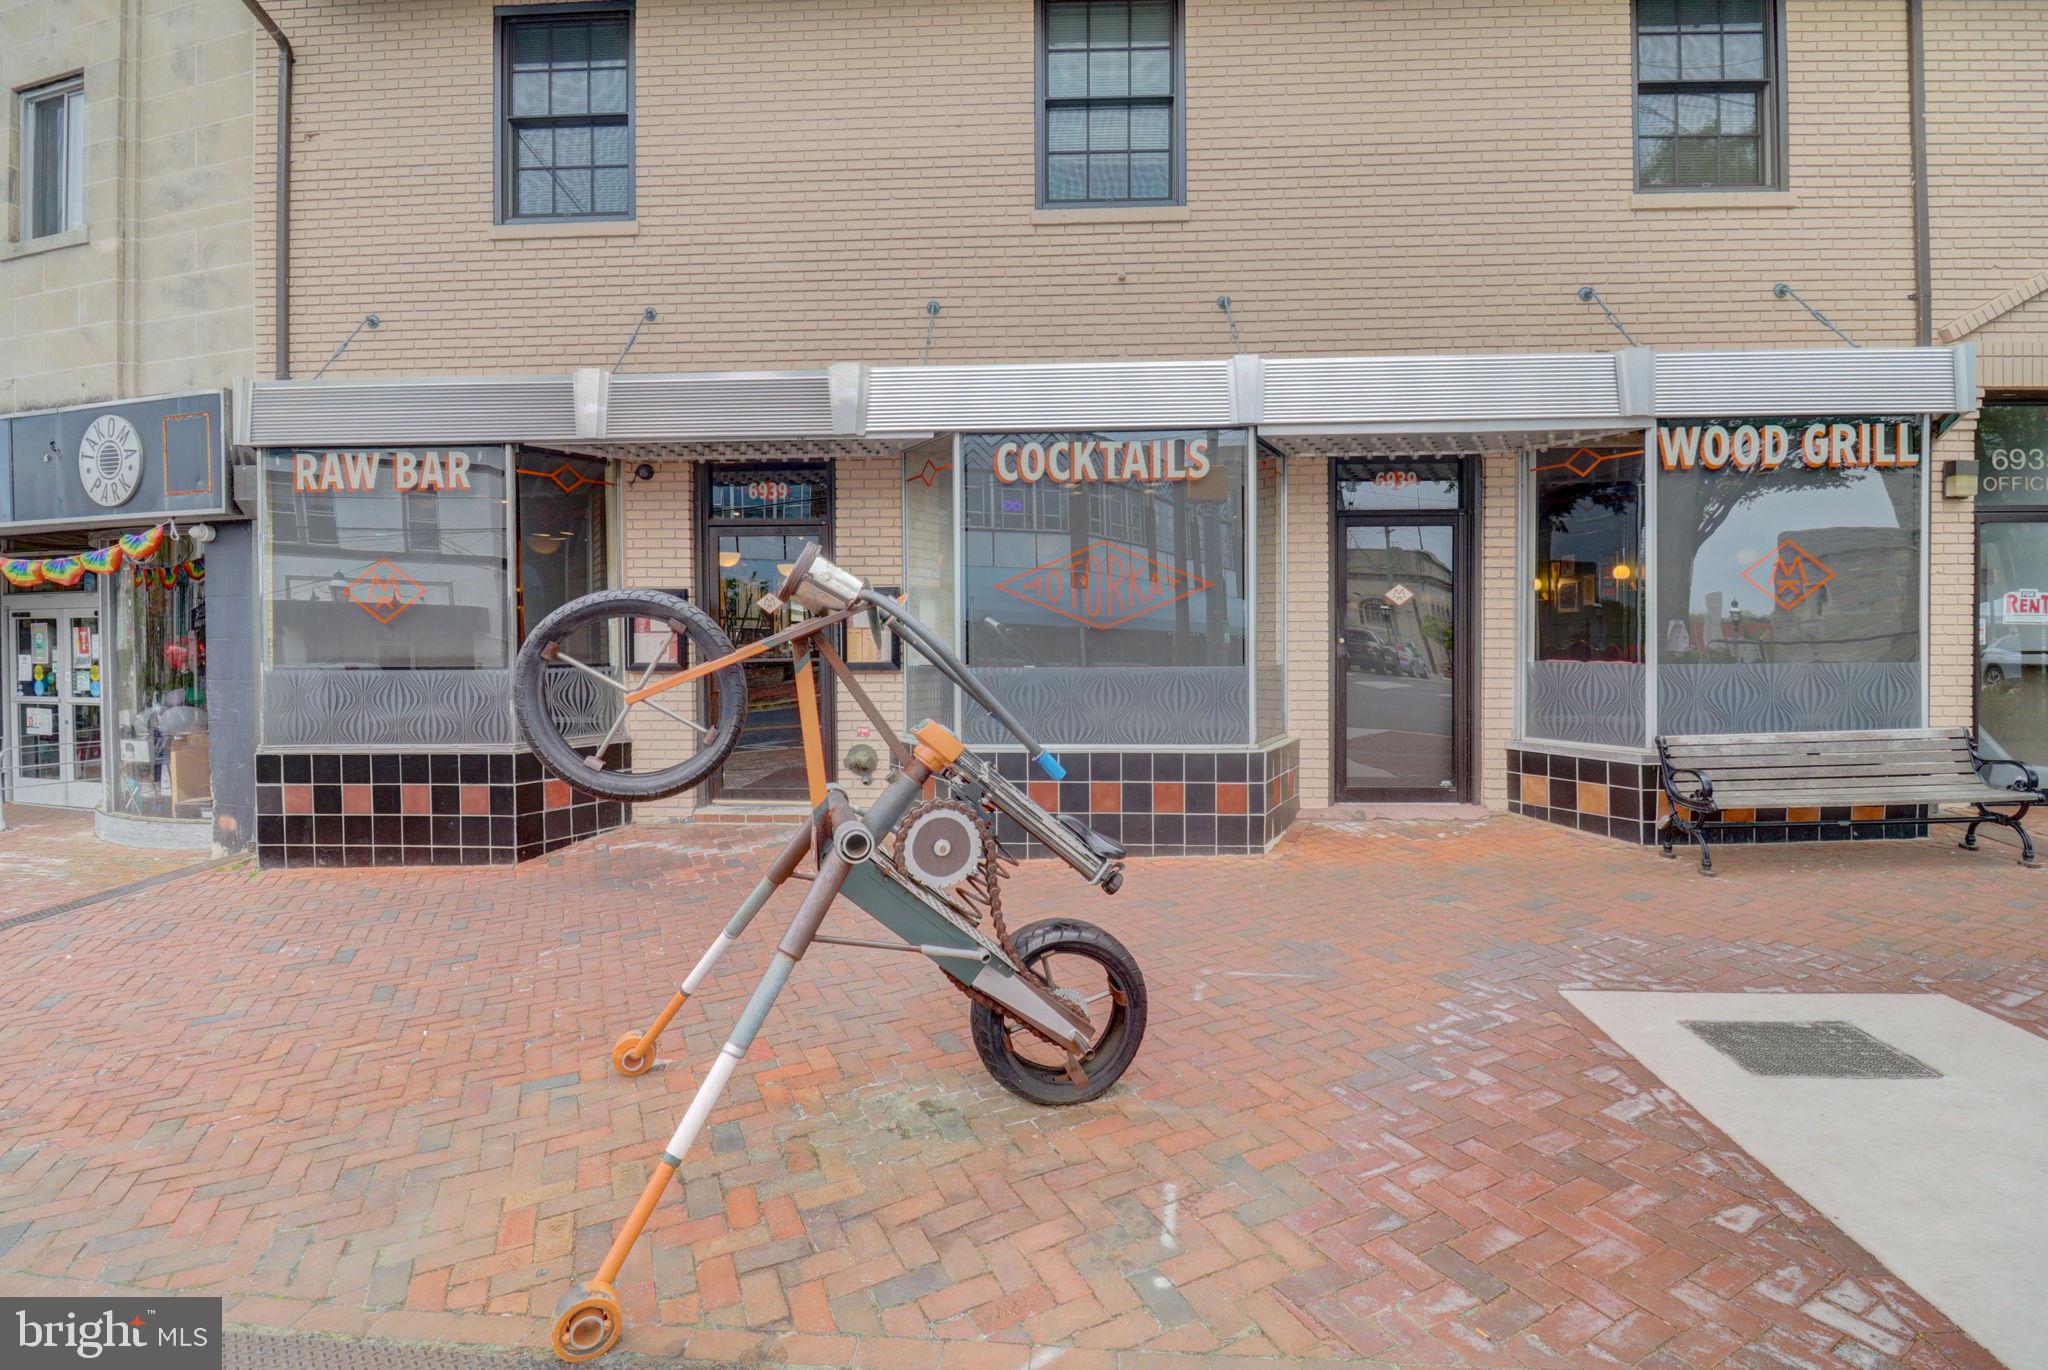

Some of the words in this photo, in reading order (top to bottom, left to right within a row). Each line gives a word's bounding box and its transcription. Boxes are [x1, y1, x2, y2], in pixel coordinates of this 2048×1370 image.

[81, 417, 137, 460] TAKOMA
[1657, 424, 1788, 470] WOOD
[1802, 423, 1919, 468] GRILL
[292, 452, 380, 493] RAW
[393, 450, 471, 492] BAR
[993, 440, 1210, 483] COCKTAILS
[1992, 448, 2048, 470] 693
[90, 473, 132, 503] PARK
[748, 481, 787, 500] 6939
[1375, 471, 1418, 488] 6939
